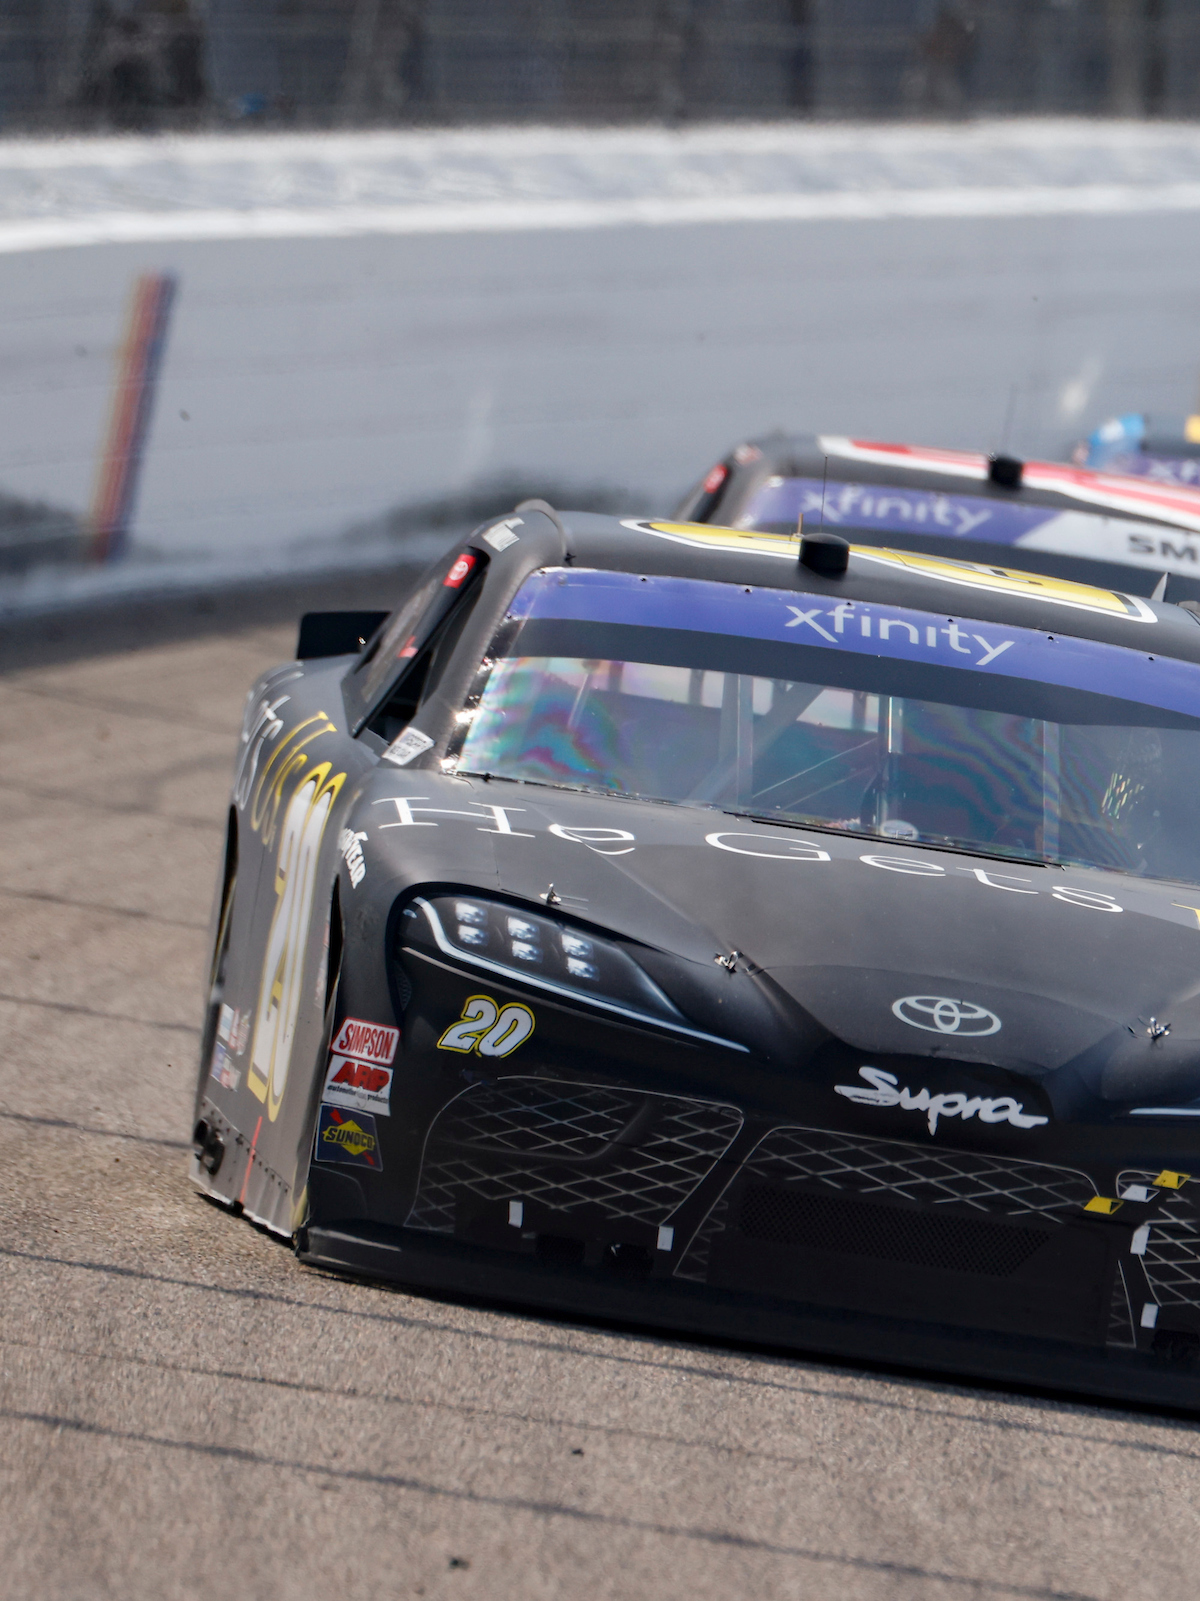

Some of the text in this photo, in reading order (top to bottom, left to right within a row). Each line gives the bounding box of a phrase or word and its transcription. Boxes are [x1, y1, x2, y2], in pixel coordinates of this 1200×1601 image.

[801, 485, 992, 536] xfinity
[785, 604, 1016, 667] xfinity
[372, 797, 635, 856] He
[704, 832, 1124, 914] Gets
[339, 1023, 395, 1060] SIMPSON
[437, 994, 536, 1059] 20
[331, 1061, 390, 1093] ARP
[834, 1066, 1049, 1136] Supra
[326, 1127, 374, 1150] SUNOCO
